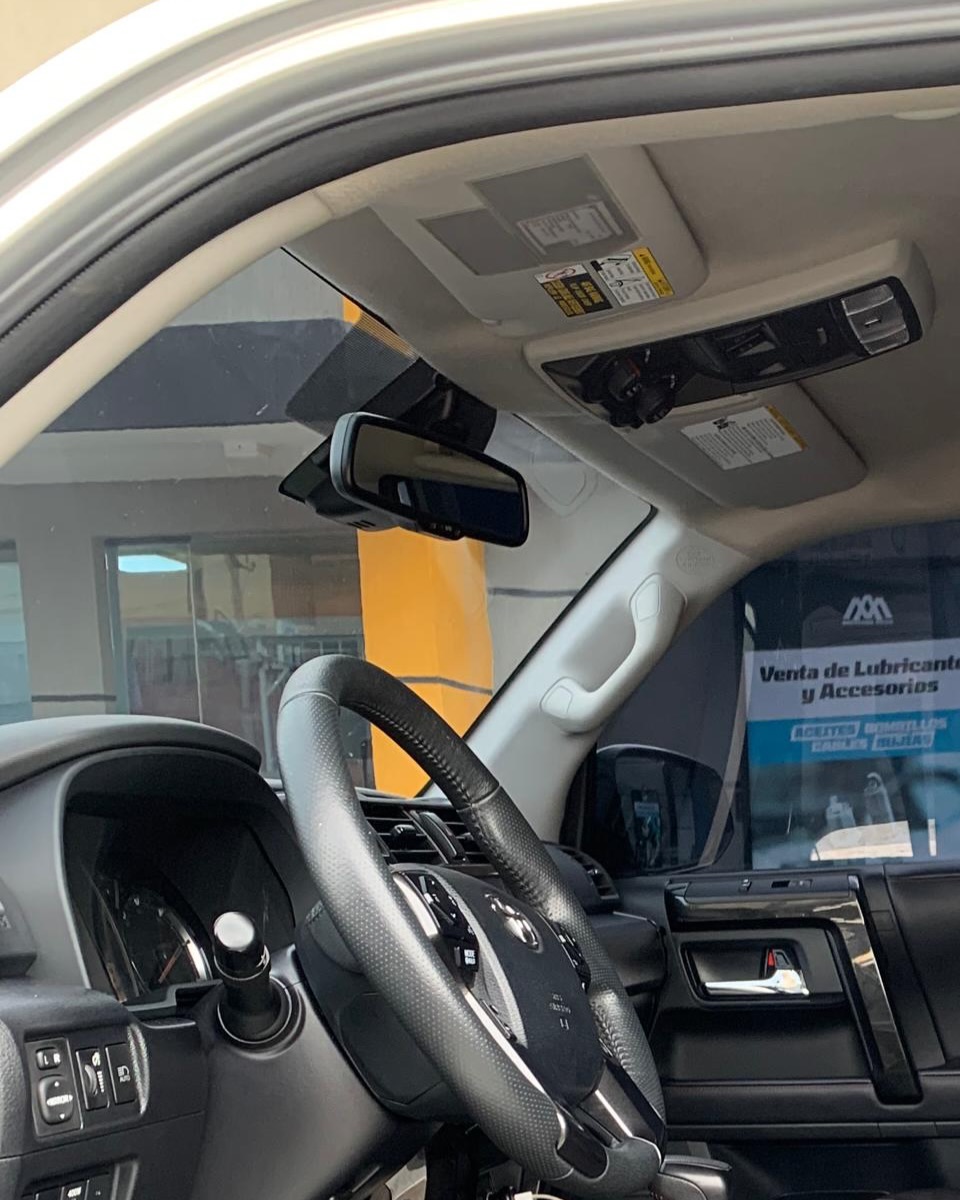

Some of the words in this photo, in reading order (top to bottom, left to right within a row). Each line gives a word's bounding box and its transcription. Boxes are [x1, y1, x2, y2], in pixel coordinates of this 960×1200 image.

[760, 665, 819, 683] Venta
[824, 662, 850, 679] de
[802, 689, 815, 704] y
[819, 678, 940, 700] Accesorios
[43, 1055, 49, 1065] L
